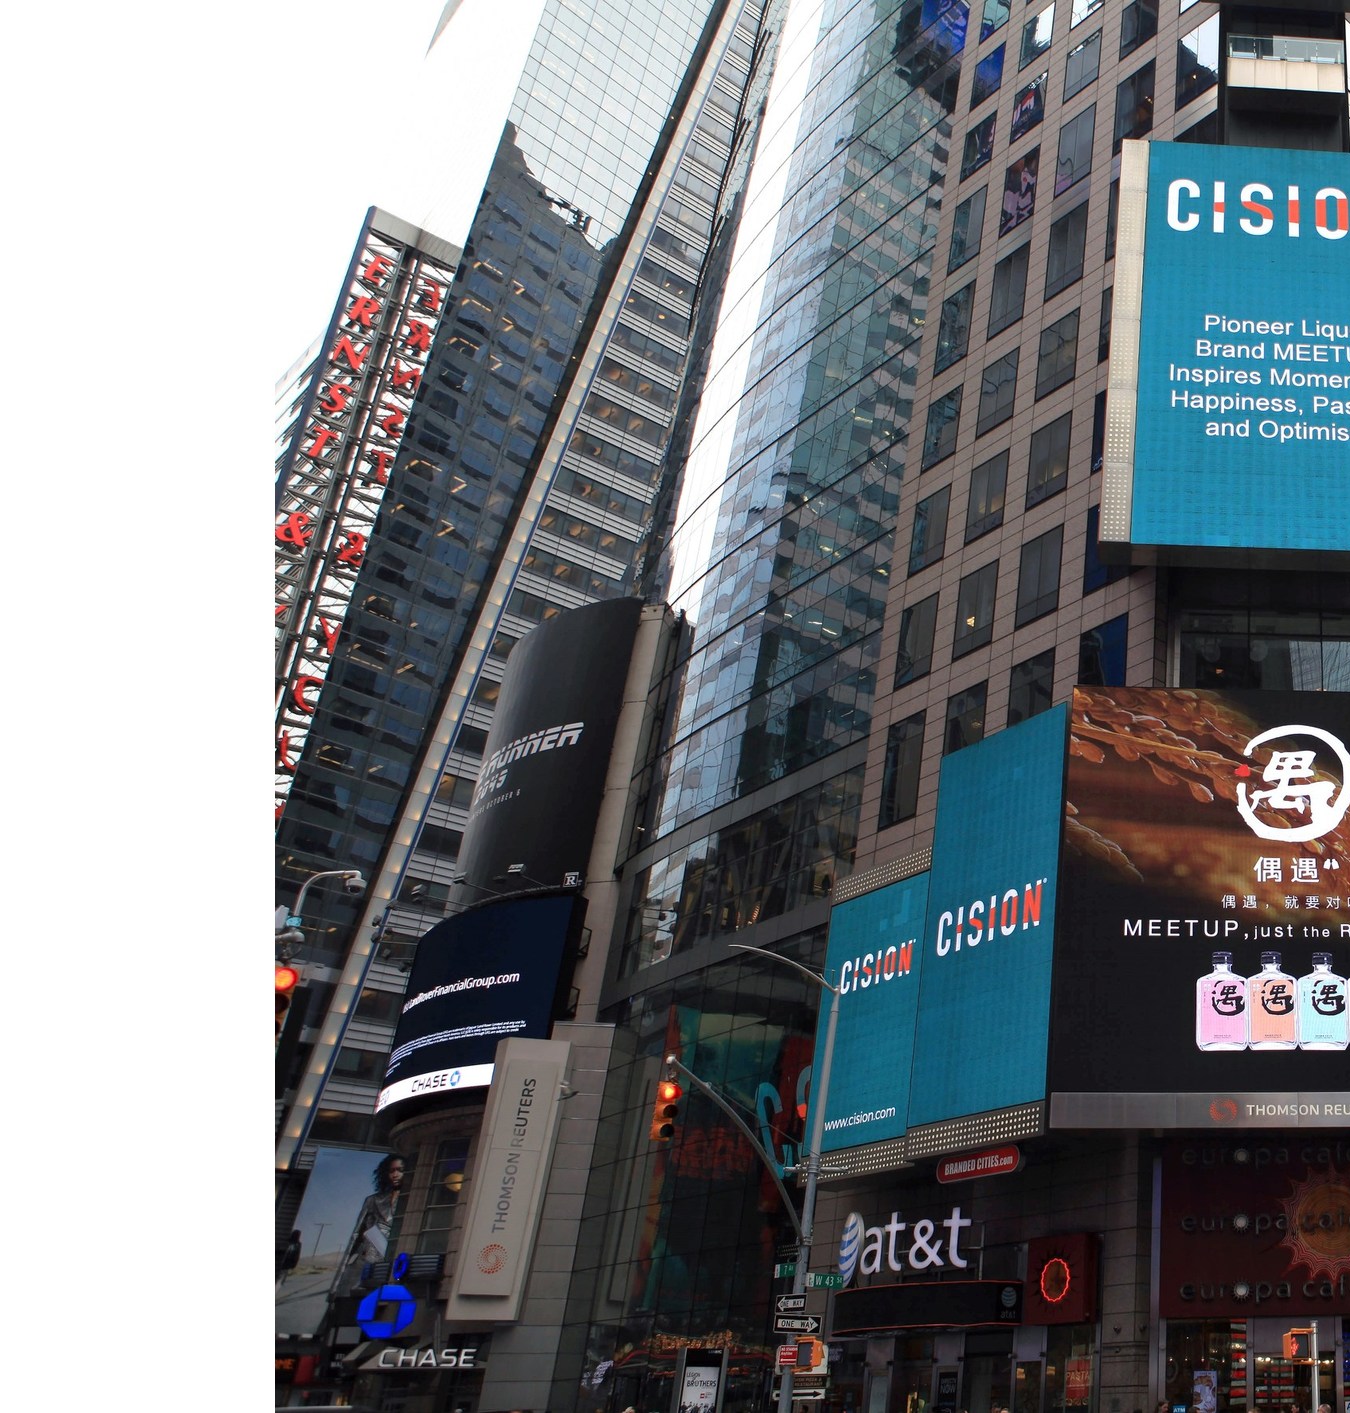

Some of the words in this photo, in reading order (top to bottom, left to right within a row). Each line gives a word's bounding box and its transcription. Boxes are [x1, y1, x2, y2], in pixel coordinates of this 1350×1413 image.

[1204, 315, 1294, 336] Pioneer
[308, 256, 393, 458] ERNST
[1196, 339, 1265, 360] Brand
[1169, 364, 1262, 391] Inspires
[1171, 390, 1304, 416] Happiness,
[1205, 419, 1250, 438] and
[1253, 856, 1321, 883] 偶遇
[1302, 925, 1331, 938] the
[411, 1073, 449, 1093] CHASE
[824, 1106, 896, 1131] www.cision.com
[1246, 1104, 1320, 1116] THOMSON
[491, 1152, 521, 1233] THOMSON
[511, 1078, 537, 1148] REUTERS
[944, 1160, 976, 1176] BRANDED
[976, 1154, 1013, 1171] CITIES.com
[860, 1206, 972, 1275] at&t
[815, 1276, 823, 1286] W
[825, 1277, 834, 1287] 43
[780, 1300, 790, 1308] ONE
[792, 1299, 803, 1307] WAY
[781, 1320, 795, 1328] ONE
[800, 1321, 815, 1329] WAY
[377, 1348, 477, 1367] CHASE
[1173, 1405, 1186, 1413] ATM
